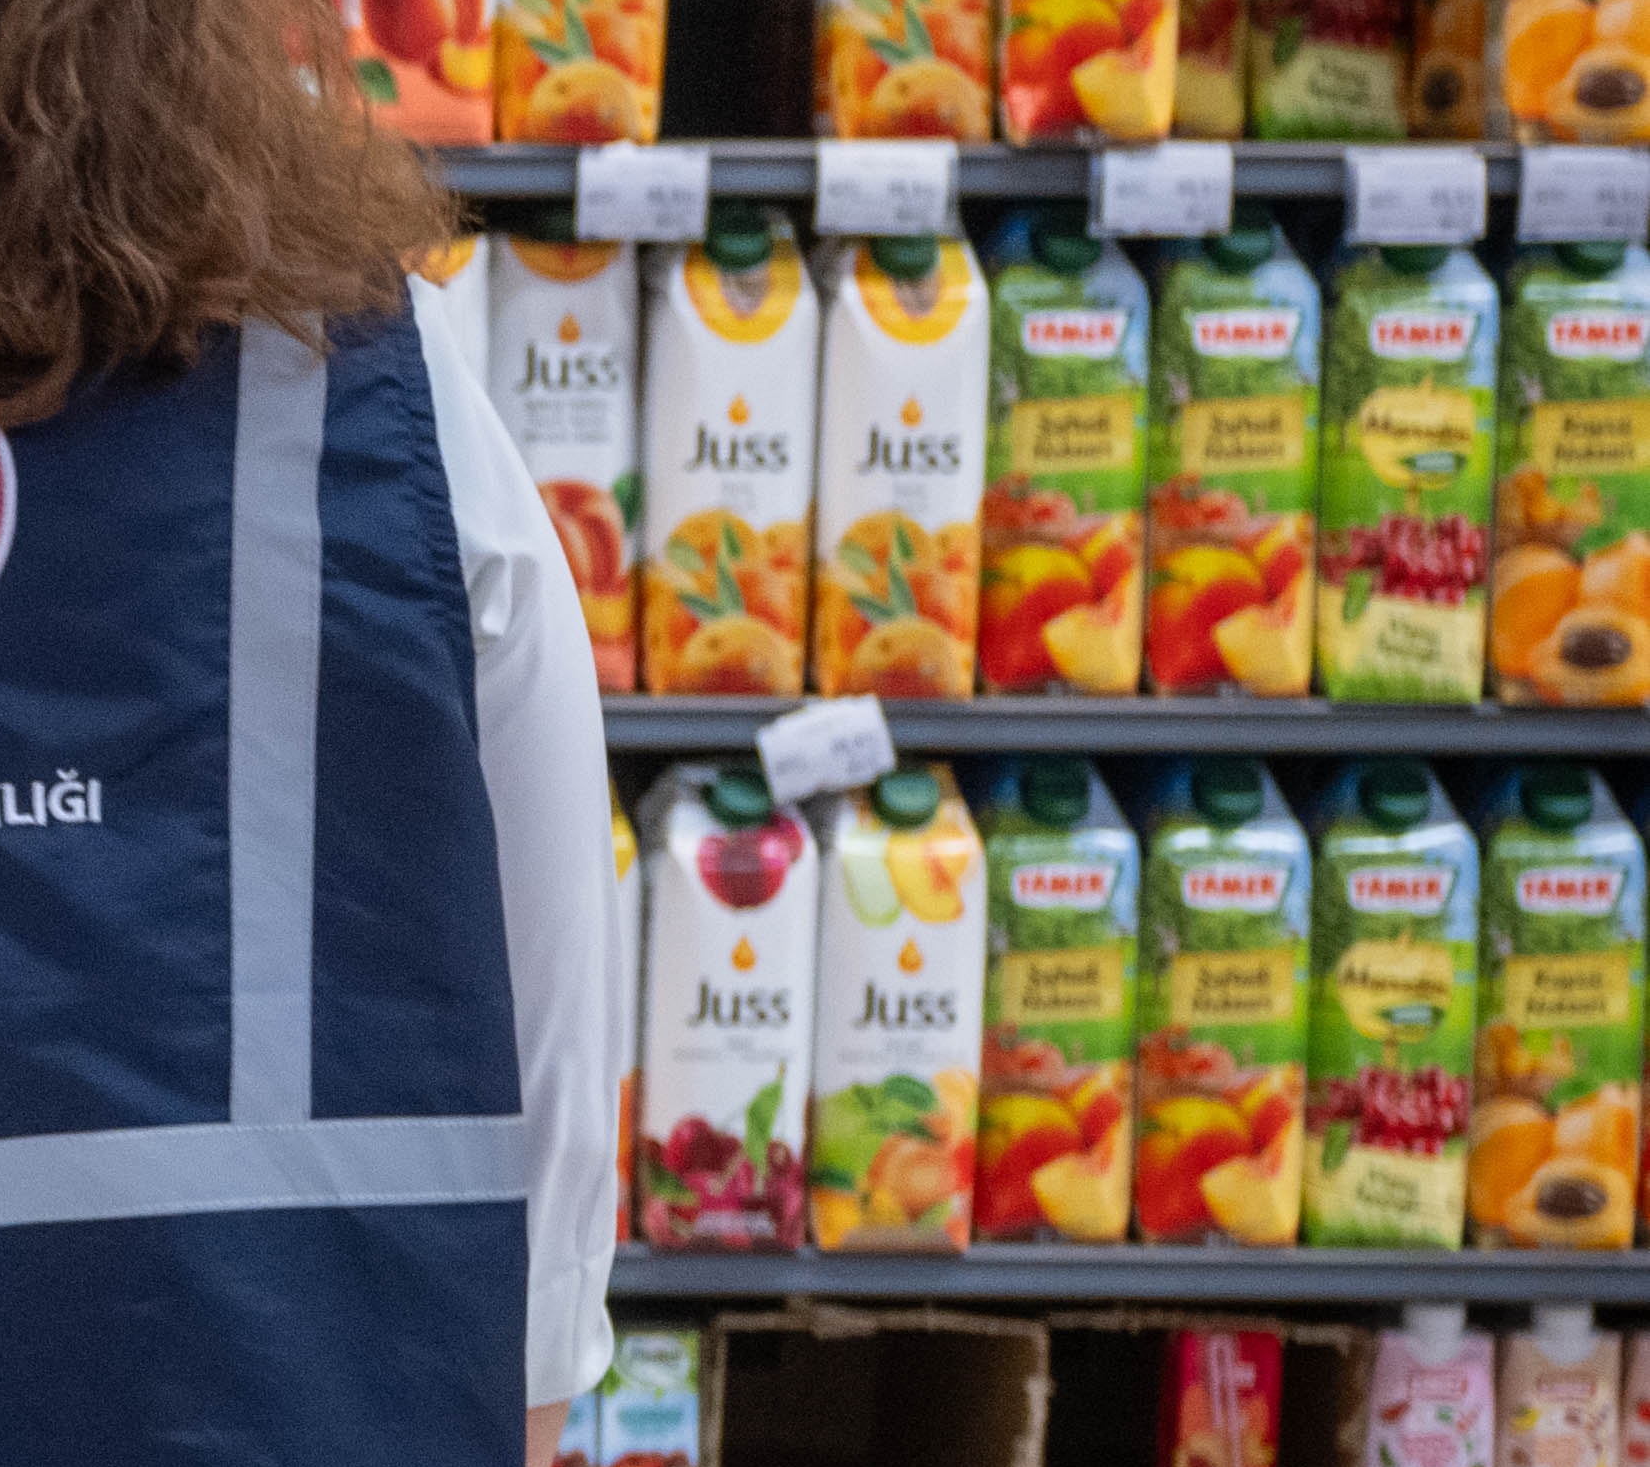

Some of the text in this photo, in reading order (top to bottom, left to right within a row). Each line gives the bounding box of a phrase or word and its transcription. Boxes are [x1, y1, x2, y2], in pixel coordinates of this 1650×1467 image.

[514, 342, 618, 392] Juss
[684, 423, 789, 473] Juss
[856, 423, 960, 473] Juss
[686, 982, 790, 1029] Juss
[855, 982, 958, 1029] Juss
